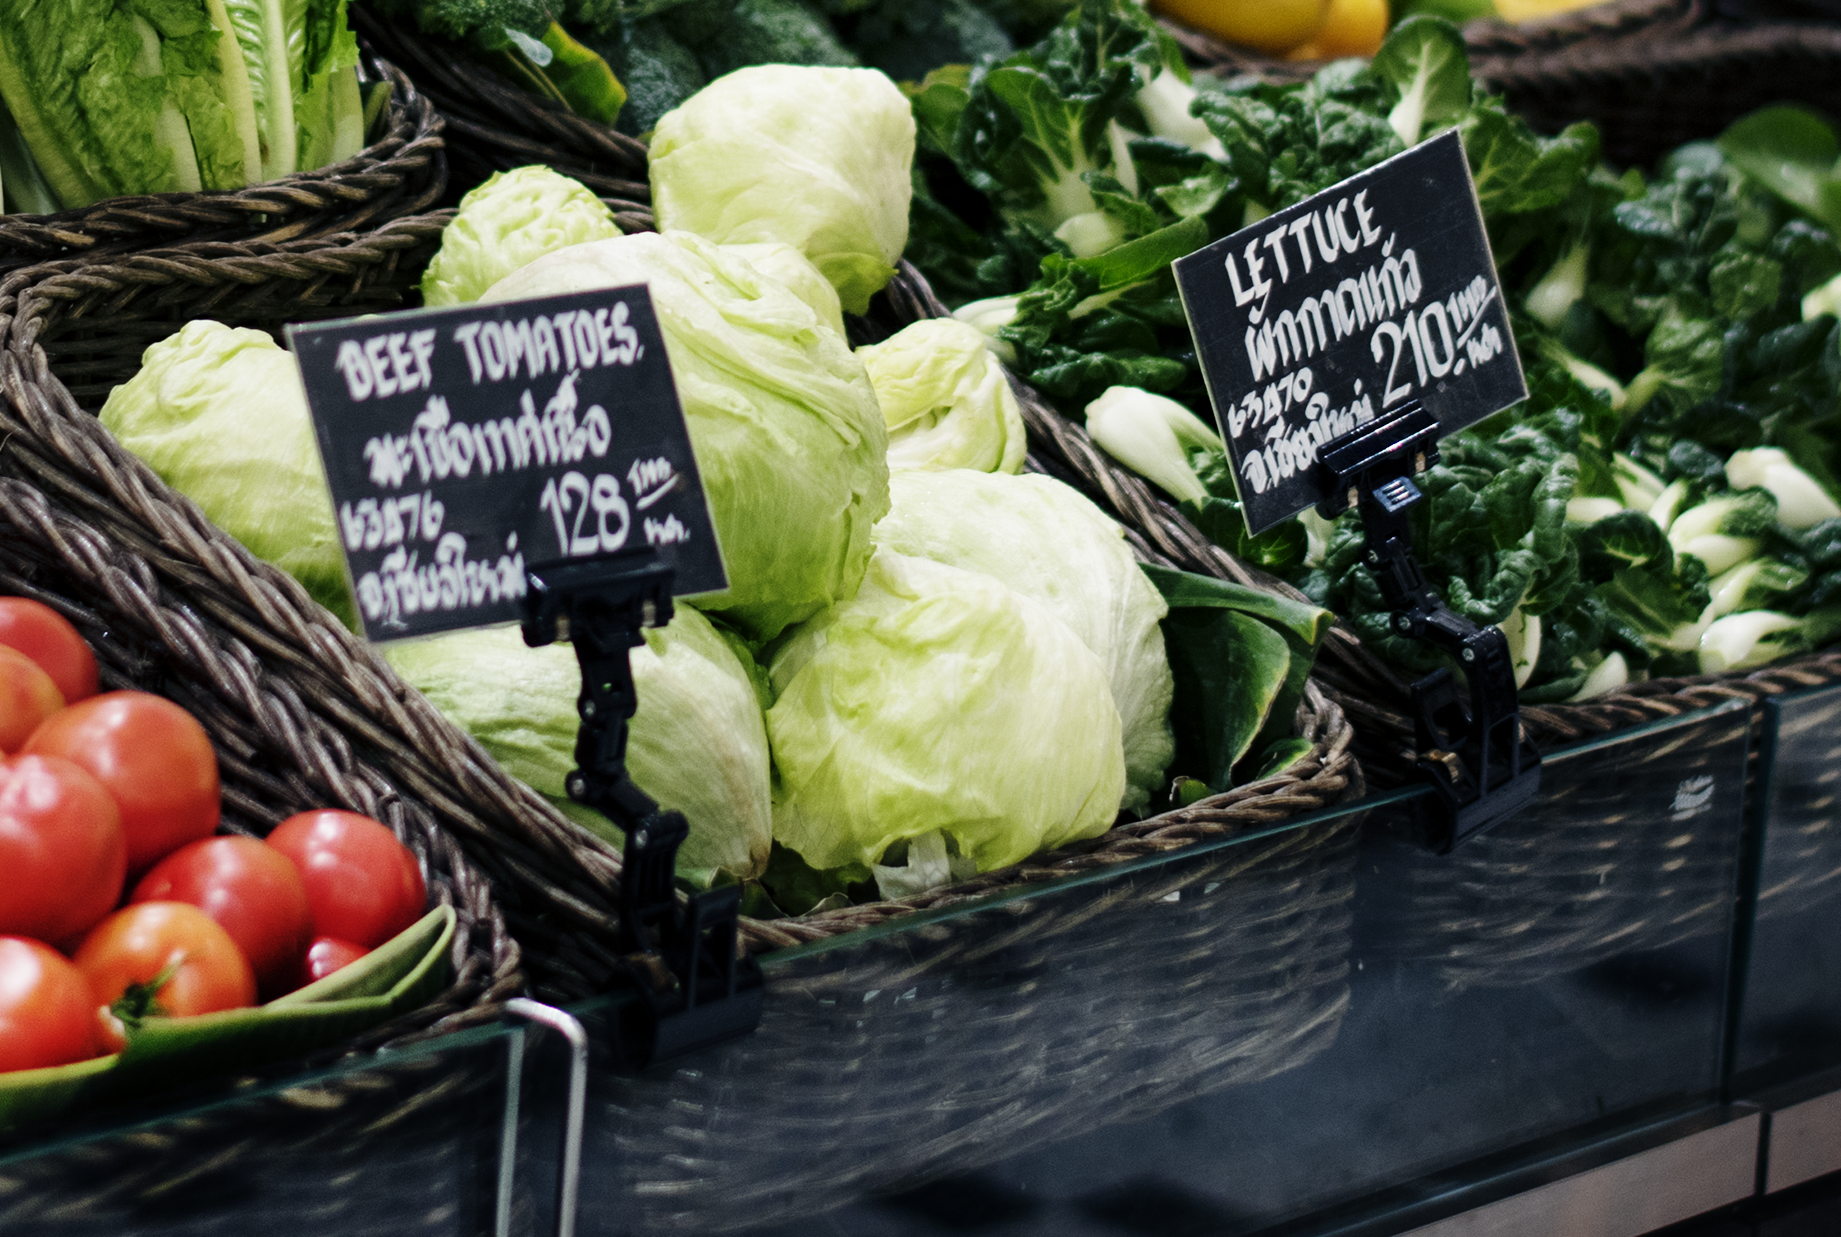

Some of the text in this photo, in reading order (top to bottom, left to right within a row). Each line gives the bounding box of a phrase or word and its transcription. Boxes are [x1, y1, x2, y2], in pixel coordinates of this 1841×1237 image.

[1225, 188, 1382, 308] LETTUCE
[335, 329, 437, 401] BEEF
[1227, 367, 1312, 439] 63470
[540, 470, 631, 558] 128
